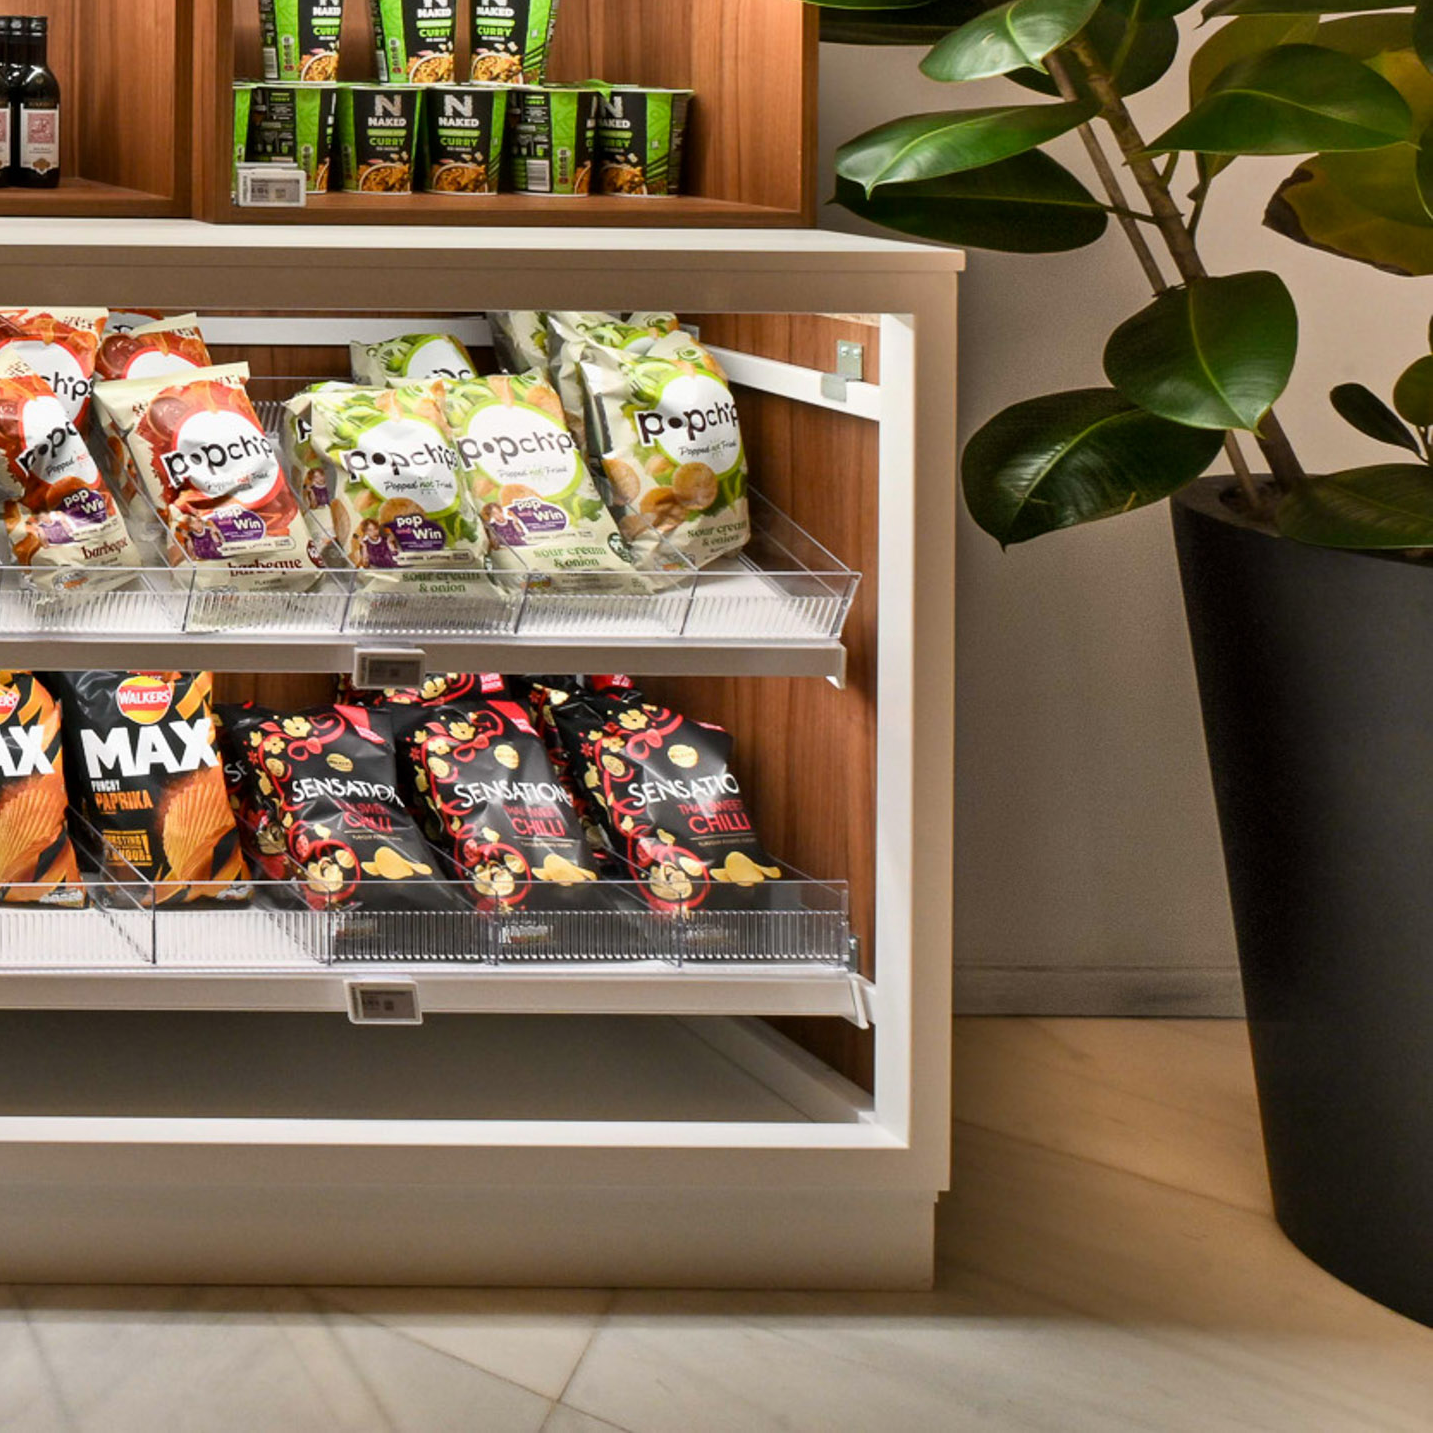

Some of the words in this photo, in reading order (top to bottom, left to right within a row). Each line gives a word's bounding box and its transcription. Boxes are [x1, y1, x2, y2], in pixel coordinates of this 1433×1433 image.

[417, 8, 452, 18] NAKED
[476, 7, 515, 17] NAKED
[477, 27, 512, 37] CURRY
[367, 117, 407, 127] NAKED
[438, 117, 479, 127] NAKED
[369, 137, 405, 146] CURRY
[440, 137, 477, 147] CURRY
[64, 489, 89, 508] pop
[80, 499, 105, 515] Win
[233, 519, 261, 531] Win
[396, 516, 422, 527] pop
[413, 528, 442, 539] Win
[534, 548, 563, 558] sour
[567, 547, 606, 556] cream
[565, 556, 599, 566] onion
[430, 582, 466, 592] onion
[118, 690, 171, 704] WALKERS
[80, 718, 219, 778] MAX
[91, 780, 120, 792] PUNCHY
[95, 790, 153, 810] PAPRIKA
[511, 818, 565, 836] CHILLI
[688, 814, 751, 834] CHILLI
